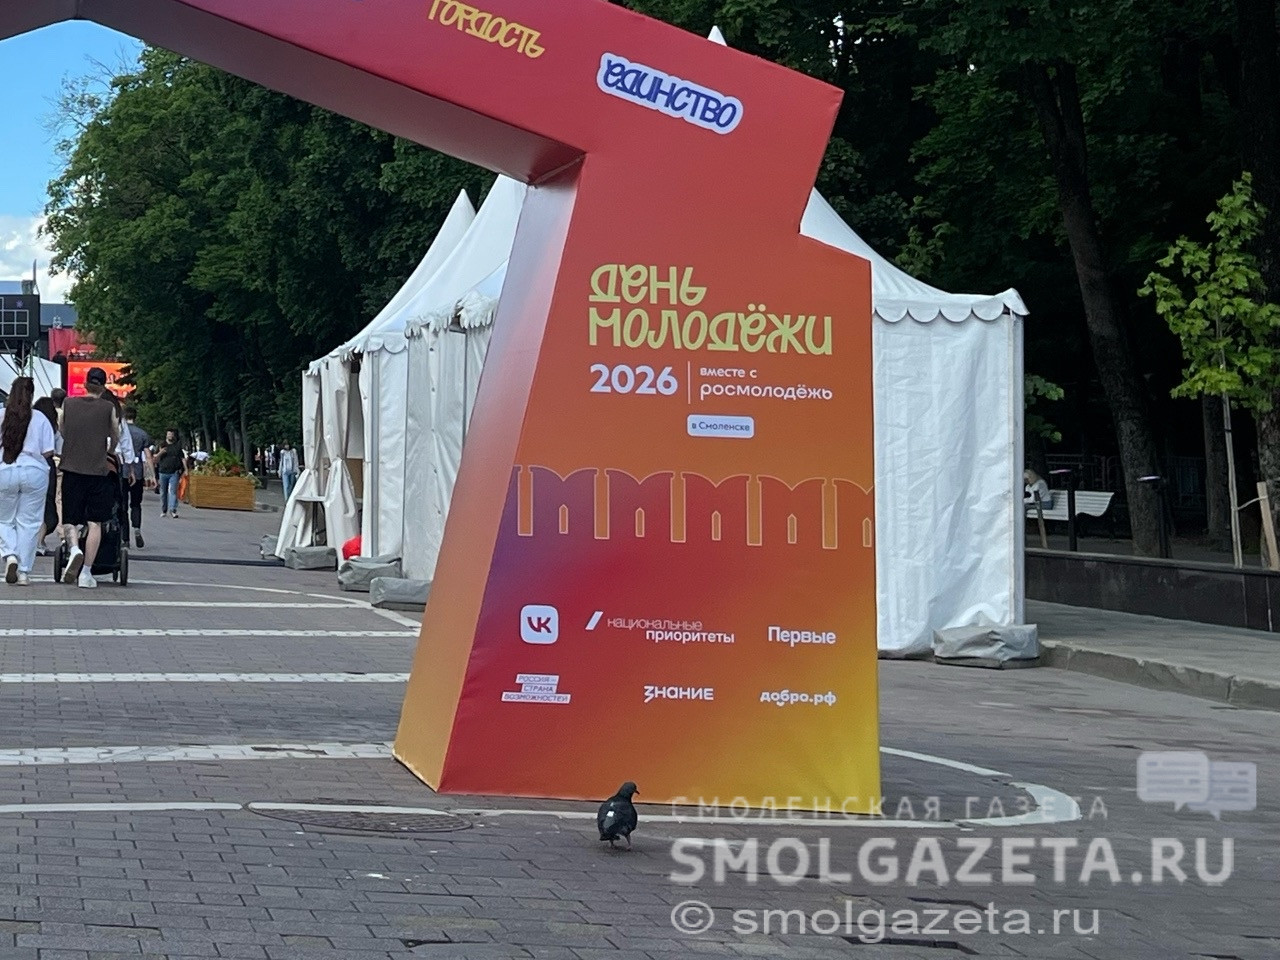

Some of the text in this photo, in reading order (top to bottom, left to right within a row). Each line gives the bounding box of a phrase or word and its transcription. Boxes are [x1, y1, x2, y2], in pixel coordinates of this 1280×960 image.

[589, 363, 678, 396] 2026
[699, 367, 758, 379] вместе с
[699, 383, 833, 401] росмолодёжь
[698, 421, 750, 432] Смоленске
[607, 617, 703, 631] национальные
[645, 629, 735, 644] приоритеты
[767, 625, 837, 647] Первые
[760, 690, 837, 706] добро.рф
